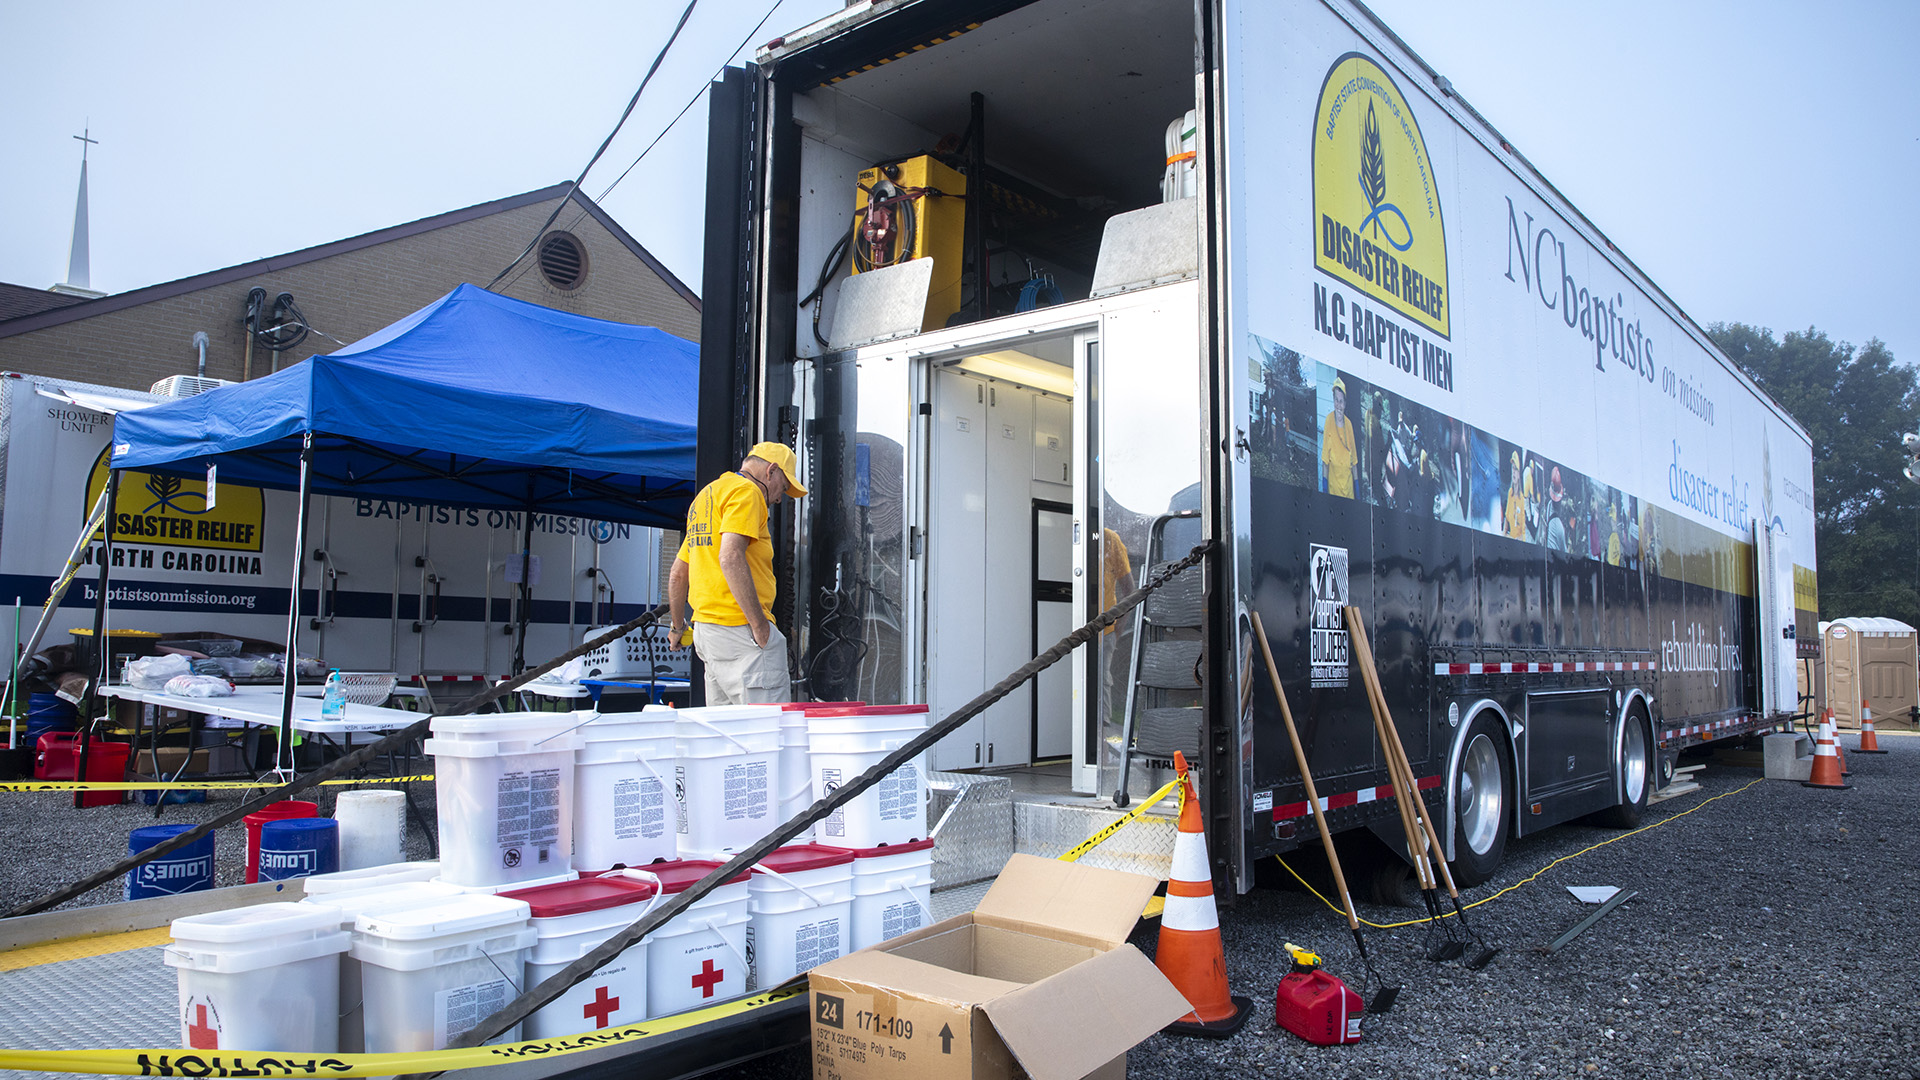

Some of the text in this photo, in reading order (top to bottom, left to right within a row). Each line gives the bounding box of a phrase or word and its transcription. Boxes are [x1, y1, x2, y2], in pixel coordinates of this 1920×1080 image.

[1326, 77, 1435, 219] BAPTIST STATE CONVENTION OF NORTH CAROLINA
[1322, 213, 1443, 322] DISASTER RELIEF
[1313, 281, 1453, 393] N.C. BAPTIST MEN
[1662, 366, 1676, 399] on
[1679, 374, 1714, 426] mission
[47, 408, 109, 426] SHOWER
[61, 420, 97, 434] UNIT
[1668, 439, 1749, 533] disaster relief
[96, 512, 255, 544] ISASTER RELIEF
[355, 499, 480, 528] BAPTISTS
[486, 510, 521, 531] ON
[162, 551, 262, 575] CAROLINA
[1317, 599, 1343, 630] BAPTIST
[1312, 631, 1347, 663] BUILDERS
[1661, 619, 1742, 688] rebuilding lives.
[143, 860, 206, 882] LOWE'S
[260, 852, 309, 869] LOWE'S
[821, 1000, 838, 1022] 24
[856, 1010, 913, 1039] 171-109
[816, 1054, 835, 1068] CHINA
[839, 1047, 867, 1064] 57174975
[852, 1037, 867, 1051] Blue
[870, 1041, 885, 1058] Poly
[888, 1045, 907, 1061] Tarps
[138, 1054, 353, 1077] CAUTION
